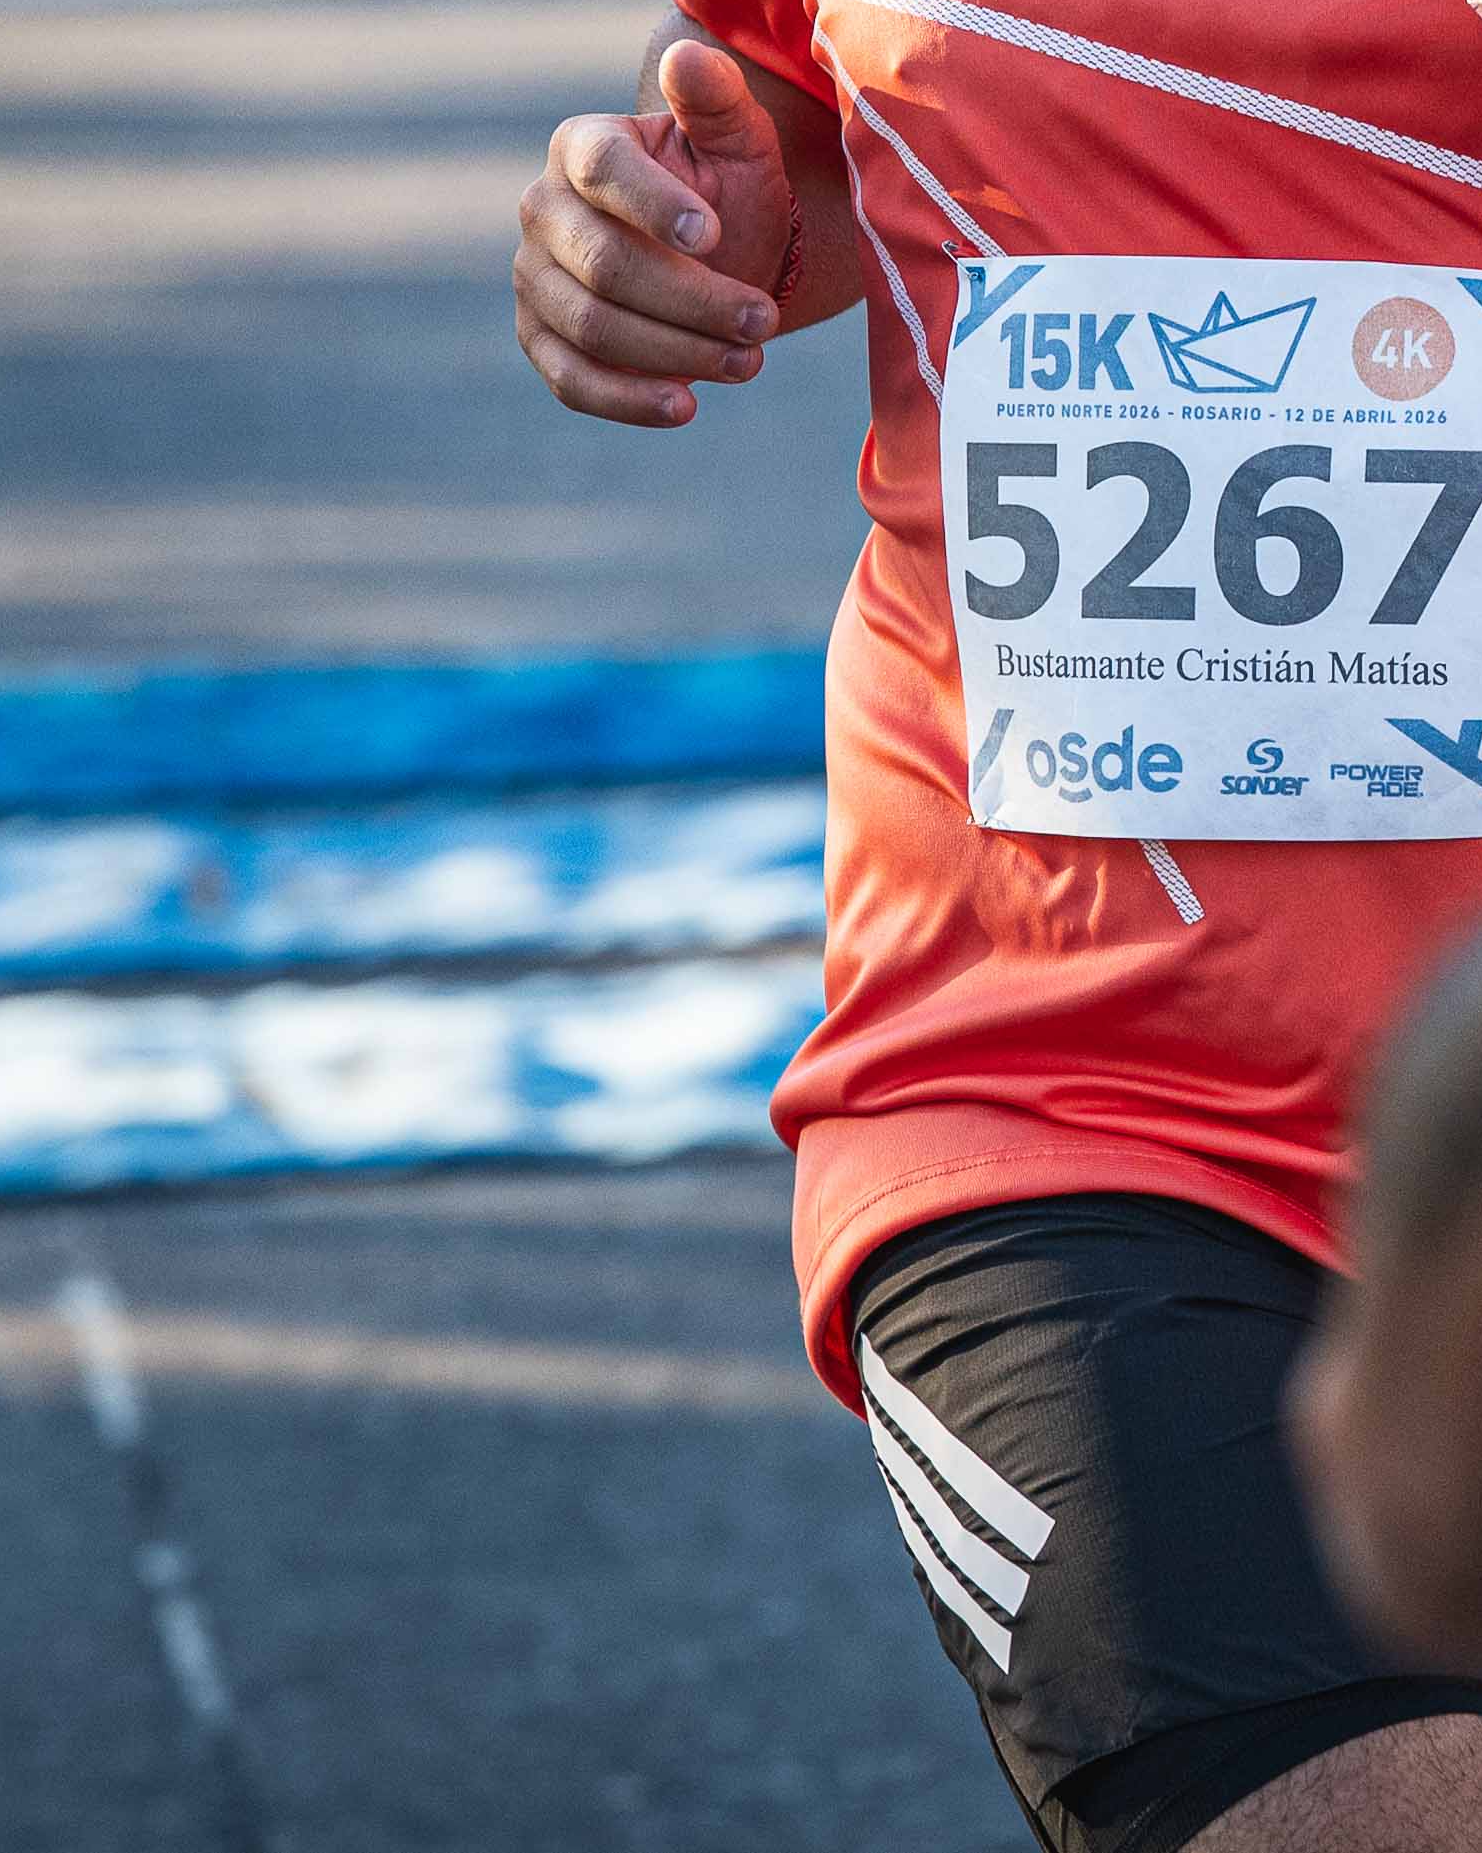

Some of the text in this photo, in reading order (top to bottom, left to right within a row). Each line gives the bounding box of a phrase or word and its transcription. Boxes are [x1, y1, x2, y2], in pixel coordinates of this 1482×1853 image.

[998, 312, 1136, 392] 15K
[1371, 328, 1433, 369] 4K
[996, 403, 1055, 419] PUERTO
[1061, 404, 1113, 420] NORTE
[1119, 404, 1160, 420] 2026
[1181, 405, 1262, 421] ROSARIO
[1285, 407, 1305, 423] 12
[1312, 408, 1336, 423] DE
[1342, 409, 1397, 424] ABRIL
[1403, 409, 1448, 425] 2026
[996, 644, 1449, 686] Bustamante Cristián Matías
[1025, 724, 1184, 794] osde
[1330, 764, 1424, 782] POWER
